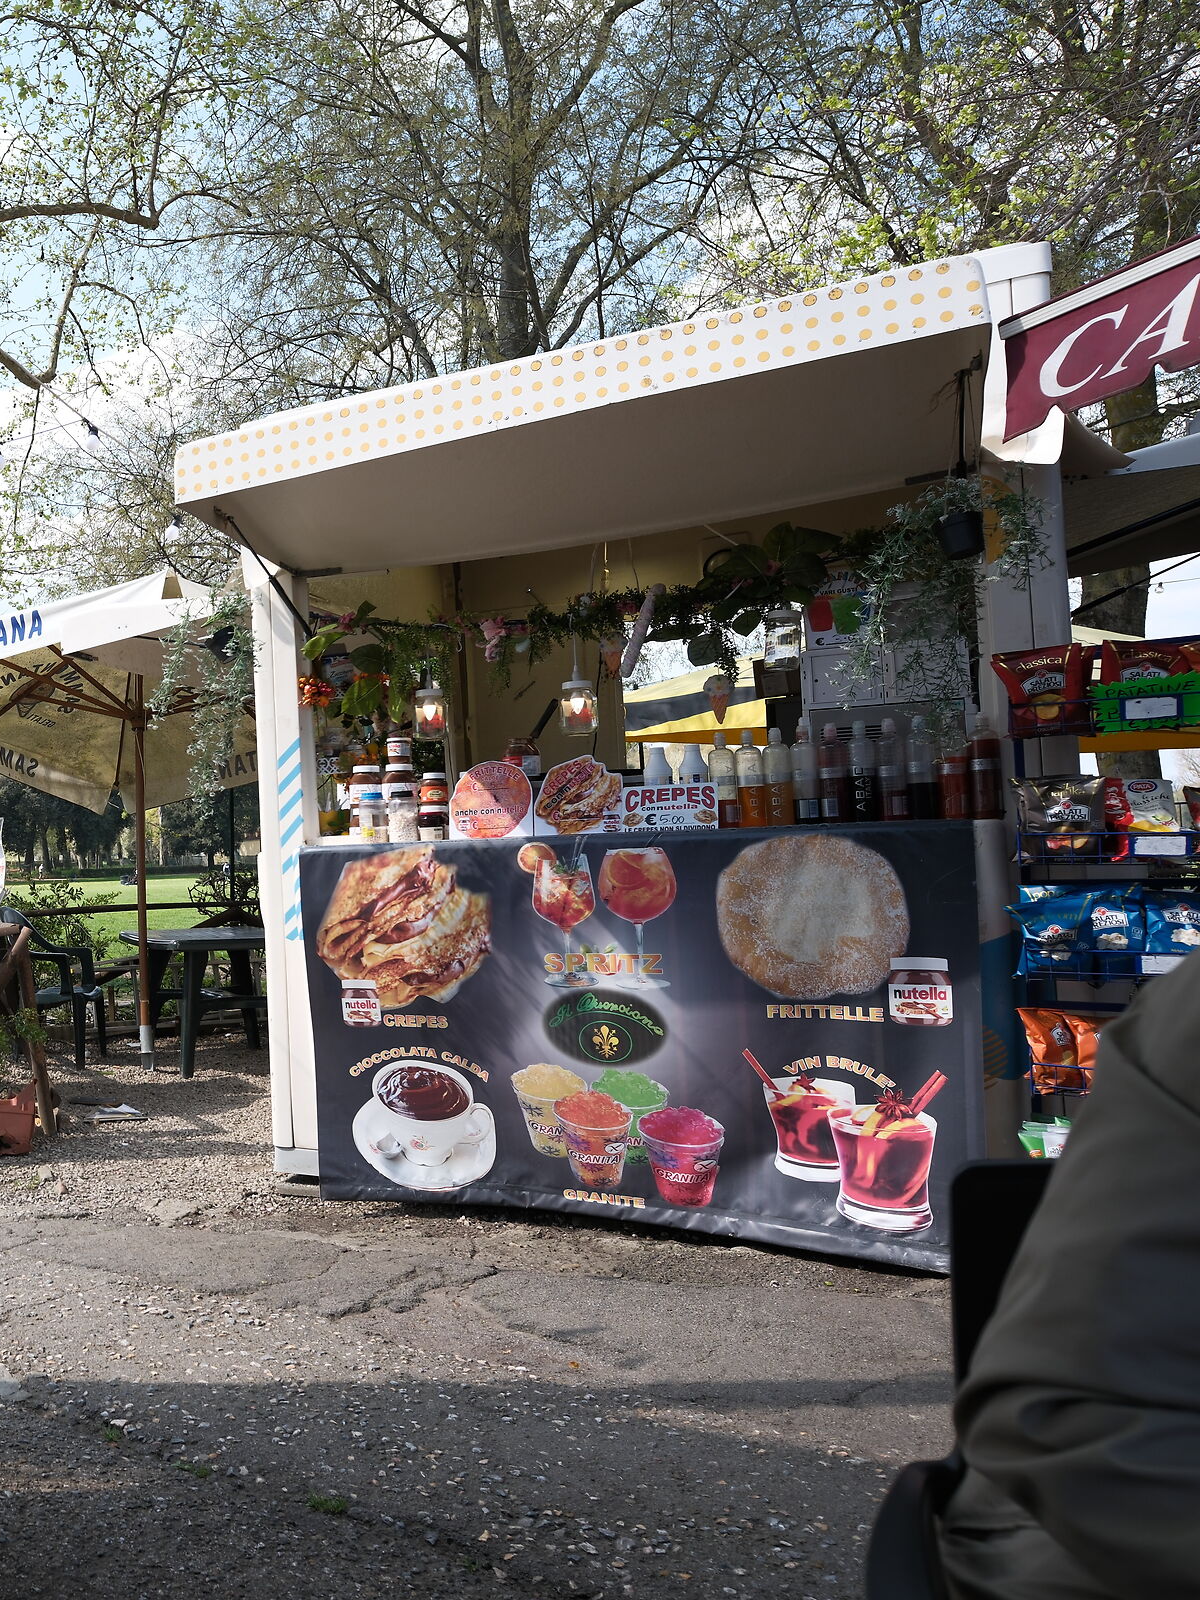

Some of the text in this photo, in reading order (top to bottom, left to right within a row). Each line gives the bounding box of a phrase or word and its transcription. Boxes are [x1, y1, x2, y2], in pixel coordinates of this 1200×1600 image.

[1039, 273, 1200, 397] CA
[1016, 655, 1063, 673] classica
[1027, 681, 1063, 694] PREZIOSI
[1029, 676, 1058, 687] SALATI
[1105, 680, 1194, 698] PATATINE
[469, 766, 521, 782] FRITTELLE
[542, 760, 583, 796] CREPES
[1132, 782, 1153, 790] PATA
[544, 789, 564, 810] con
[625, 785, 716, 812] CREPES
[454, 808, 478, 817] anche
[497, 805, 524, 814] nutella
[644, 814, 657, 826] €
[1092, 919, 1125, 929] REZIOSI
[543, 953, 663, 974] SPRITZ
[893, 987, 947, 1001] nutella
[345, 1000, 377, 1009] nutella
[383, 1013, 449, 1029] CREPES
[766, 1004, 885, 1022] FRITTELLE
[349, 1046, 490, 1083] CIOCCOLATA CALDA
[783, 1055, 821, 1076] VIN
[529, 1119, 564, 1135] GRAN
[568, 1150, 620, 1165] GRANITA
[655, 1168, 711, 1184] GRANITA
[563, 1188, 646, 1209] GRANITE
